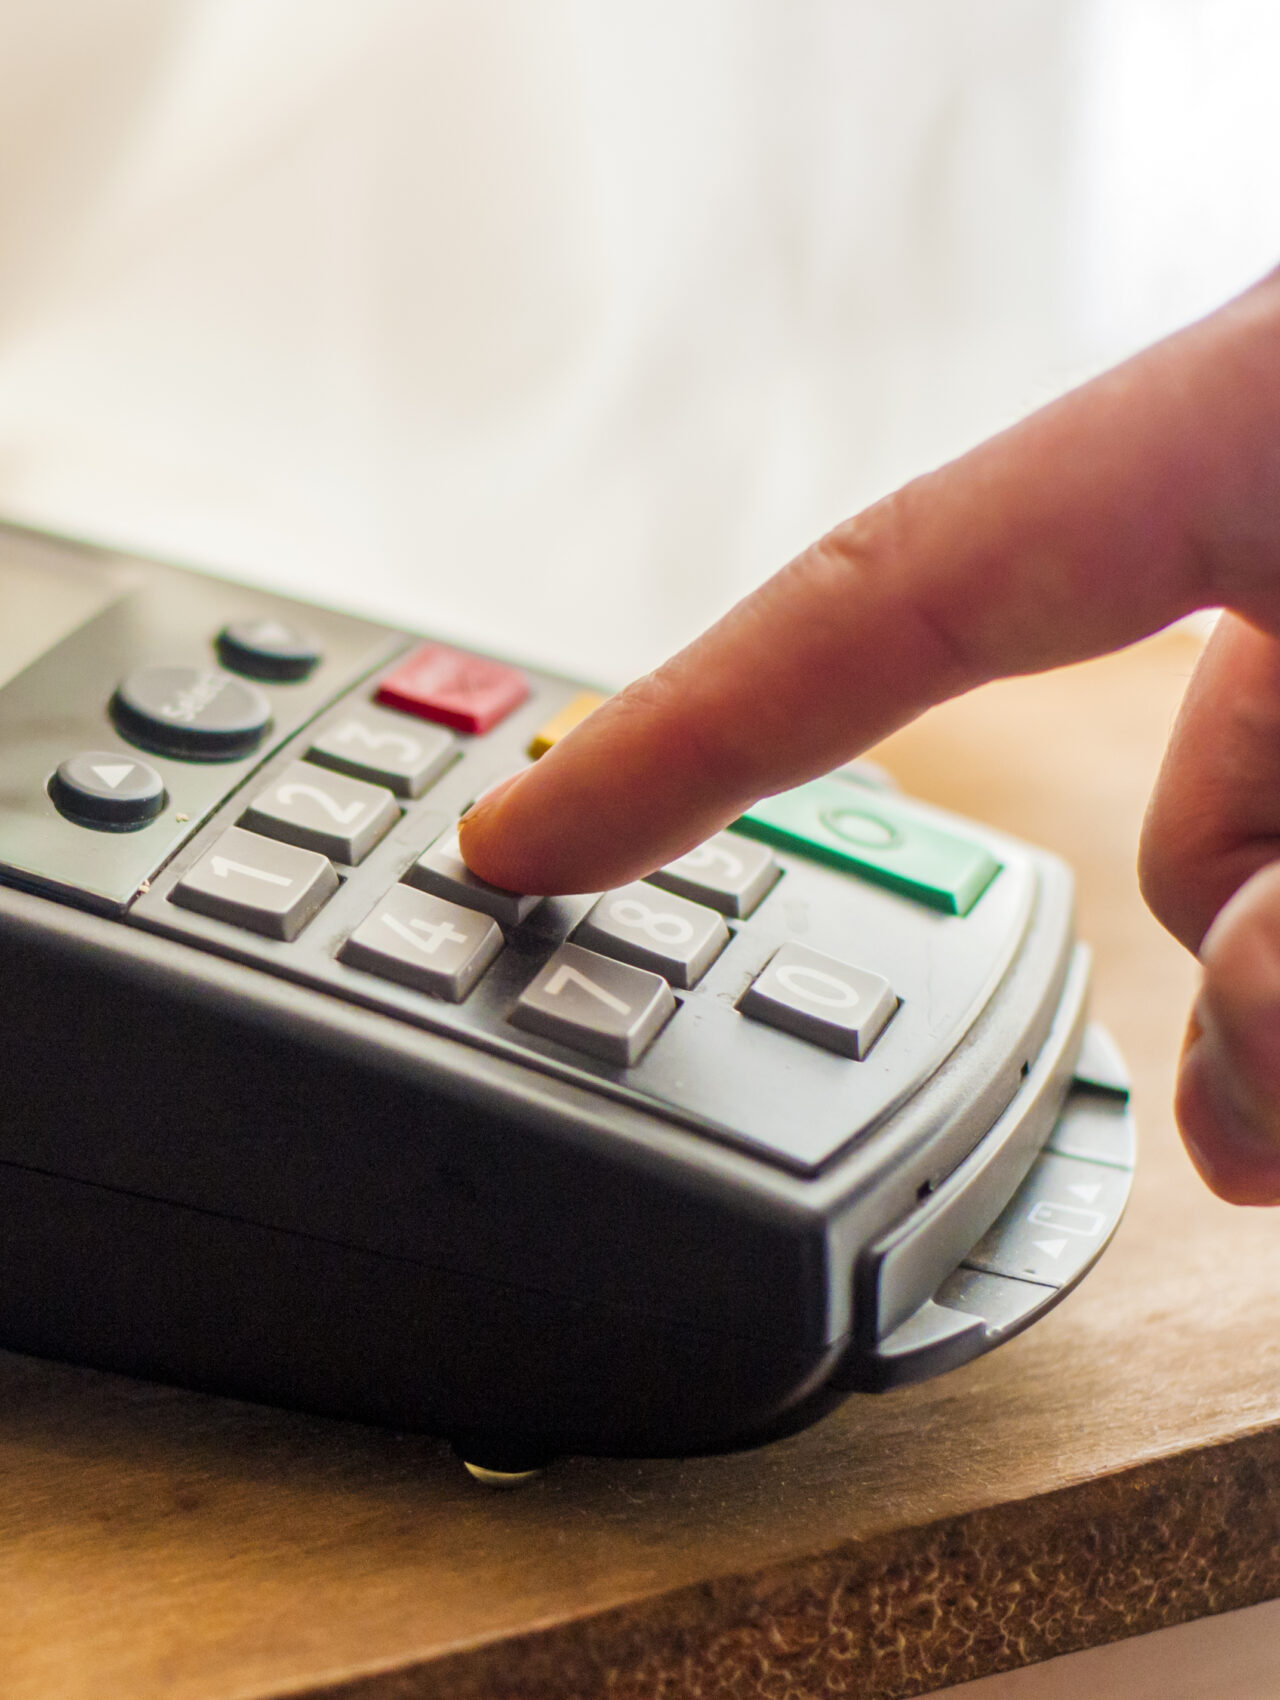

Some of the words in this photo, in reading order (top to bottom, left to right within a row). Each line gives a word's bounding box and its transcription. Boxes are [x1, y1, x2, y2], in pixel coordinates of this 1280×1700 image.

[337, 720, 420, 762] 3
[276, 783, 364, 823] 2
[210, 855, 293, 888] 1
[380, 911, 469, 953] 4
[609, 899, 694, 945] 8
[543, 964, 633, 1016] 7
[775, 964, 862, 1009] 0
